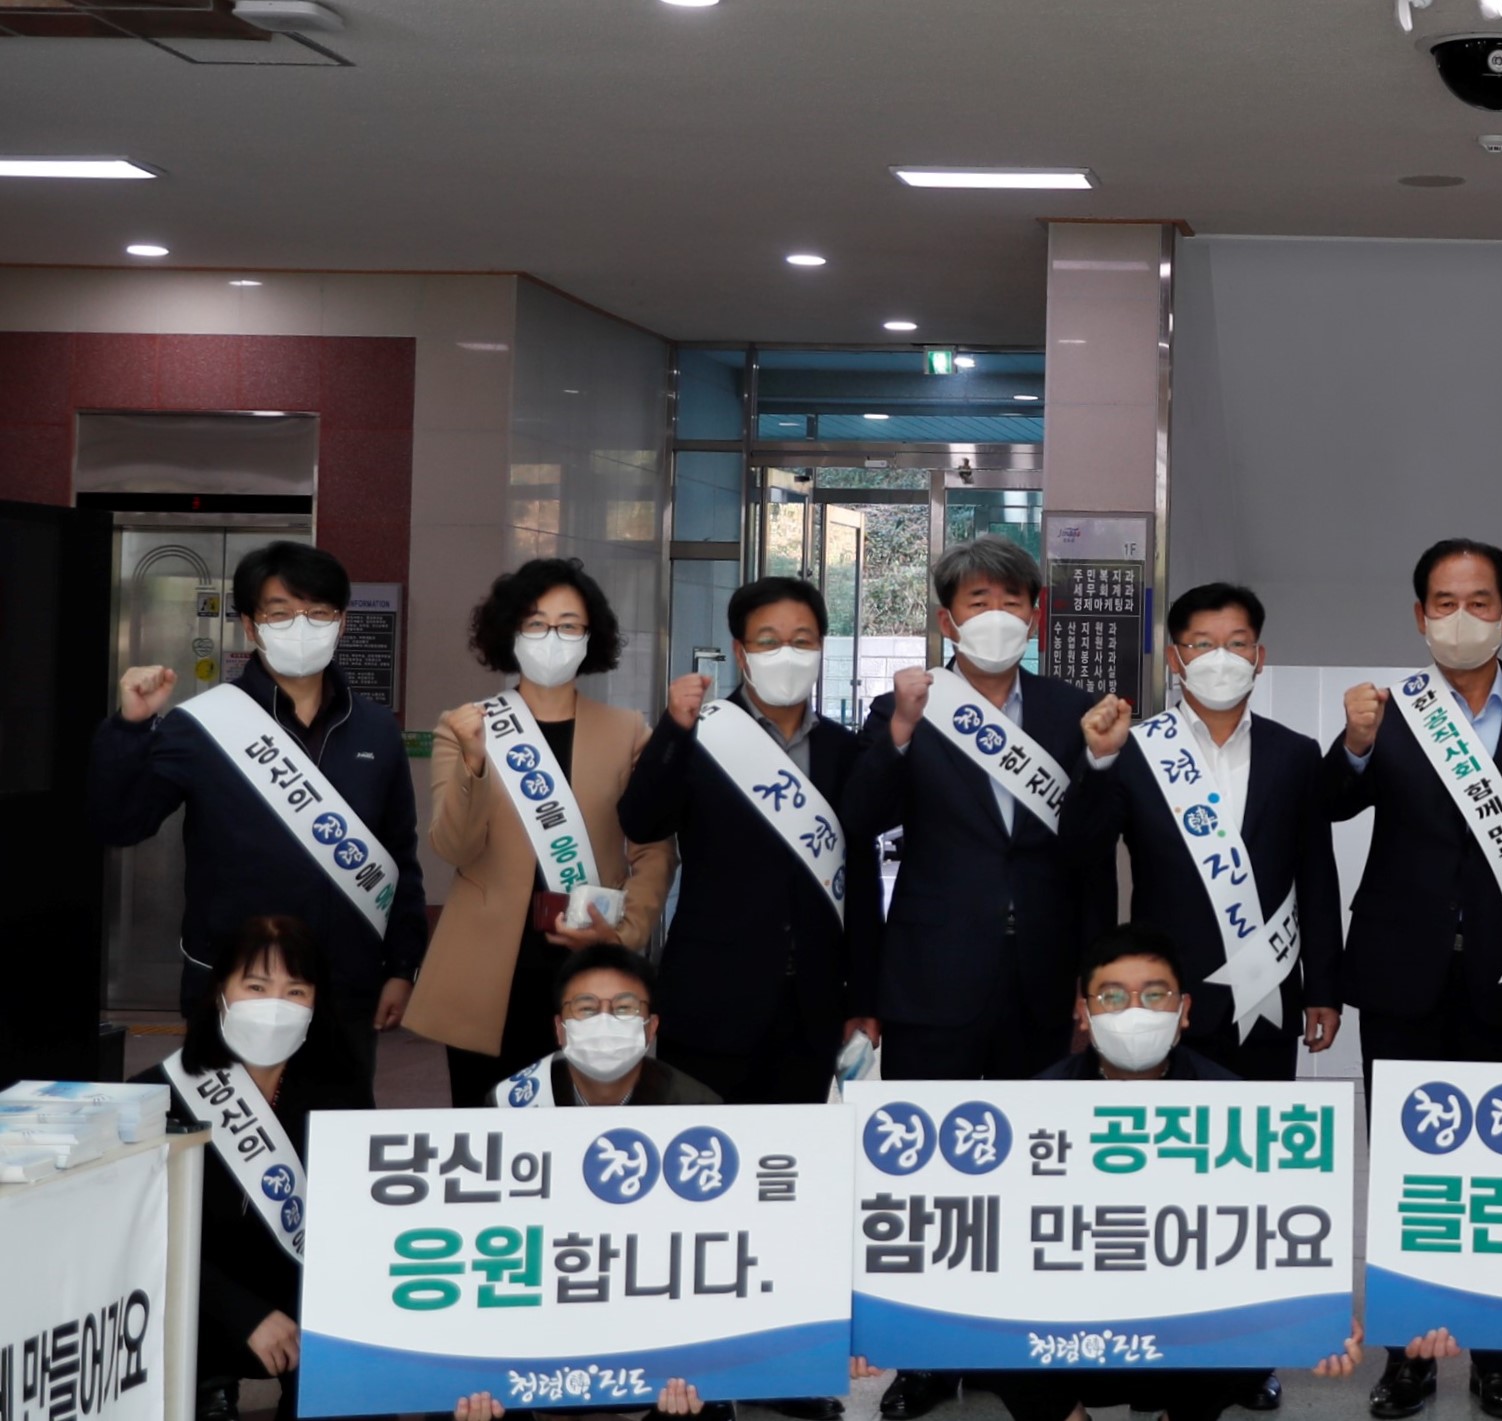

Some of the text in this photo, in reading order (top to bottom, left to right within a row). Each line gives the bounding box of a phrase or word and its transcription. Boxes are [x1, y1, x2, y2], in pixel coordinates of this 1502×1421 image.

[1124, 543, 1137, 556] 1F
[1074, 598, 1134, 612] 경제마케팅과
[244, 734, 323, 813] 당신의
[1424, 706, 1482, 780] 공직사회
[752, 769, 838, 858] 청렴
[1203, 846, 1256, 939] 진도
[196, 1070, 277, 1162] 당신의
[1090, 1103, 1334, 1174] 공직사회
[368, 1131, 552, 1206] 당신의
[389, 1224, 774, 1311] 응원합니다.
[861, 1192, 1333, 1273] 함께 만들어가요
